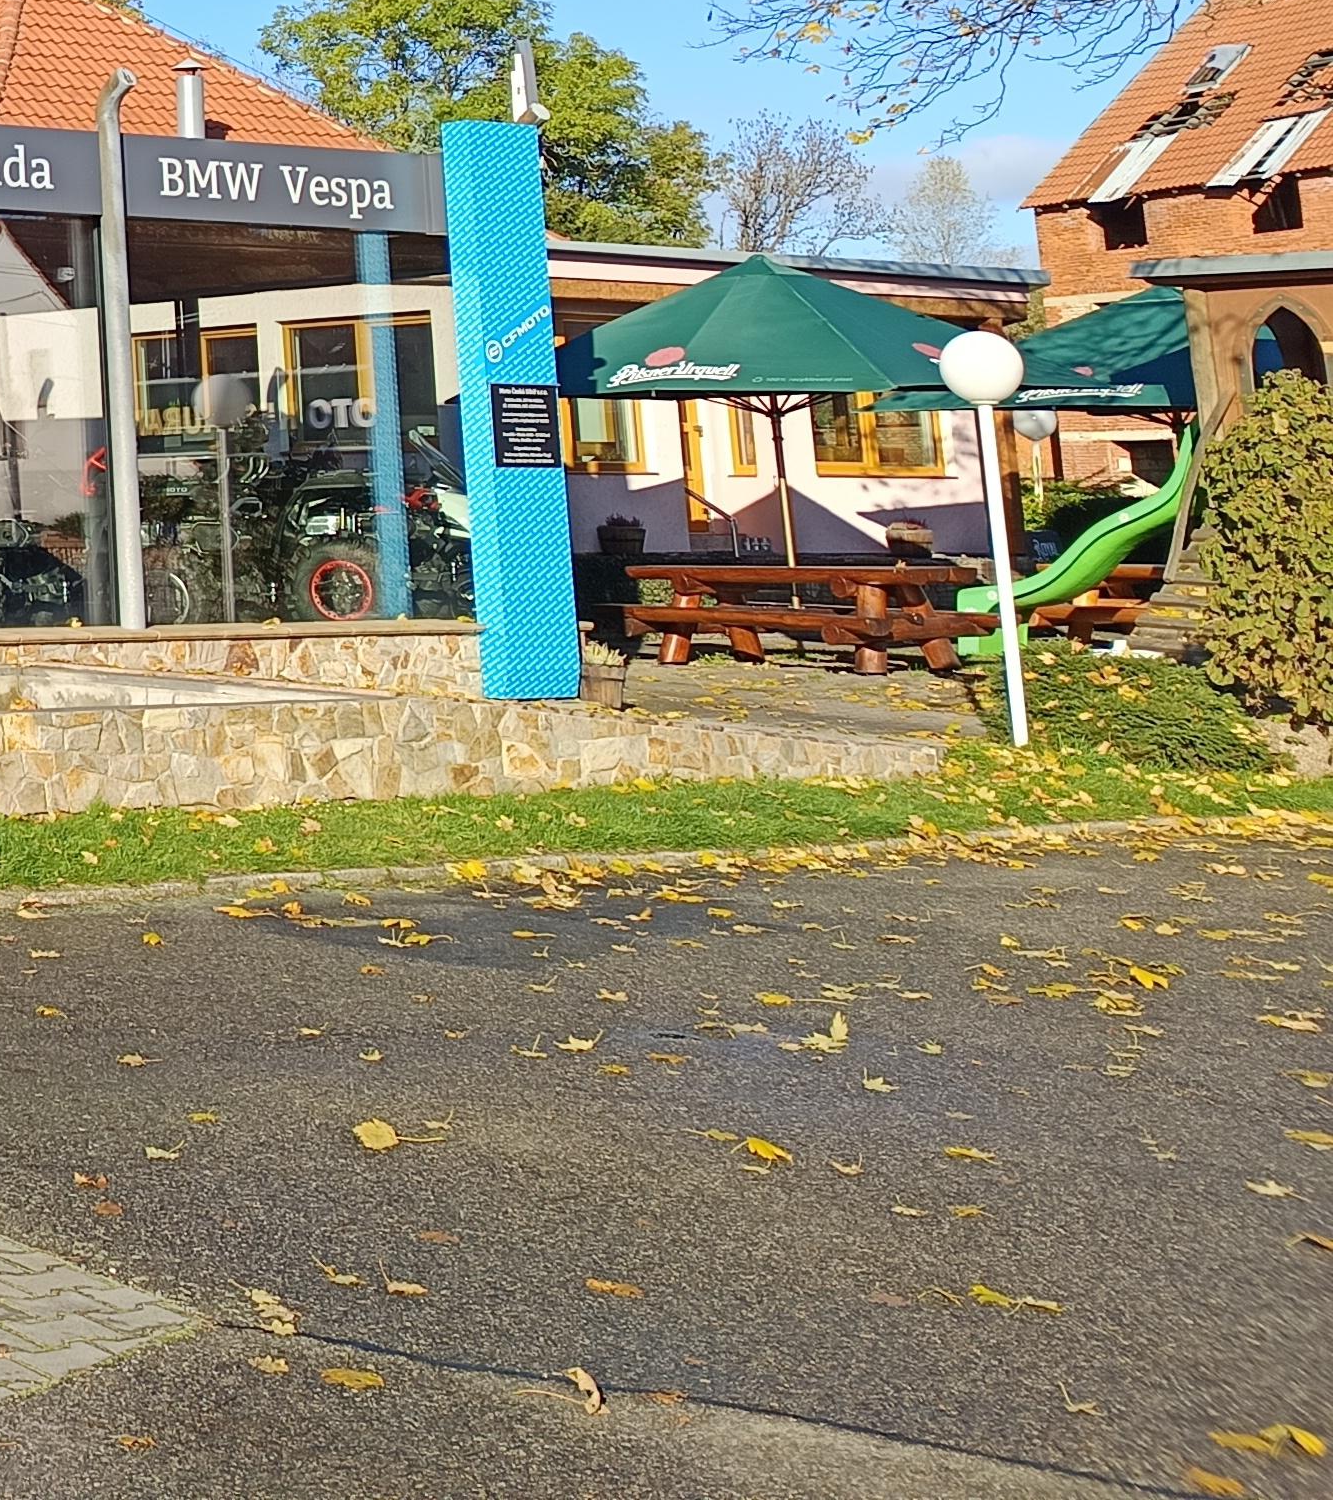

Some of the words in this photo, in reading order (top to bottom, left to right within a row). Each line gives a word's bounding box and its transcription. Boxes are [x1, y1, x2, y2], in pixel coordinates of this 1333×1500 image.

[157, 156, 264, 202] BMW
[277, 164, 396, 221] Vespa
[501, 304, 550, 348] CFMOTO
